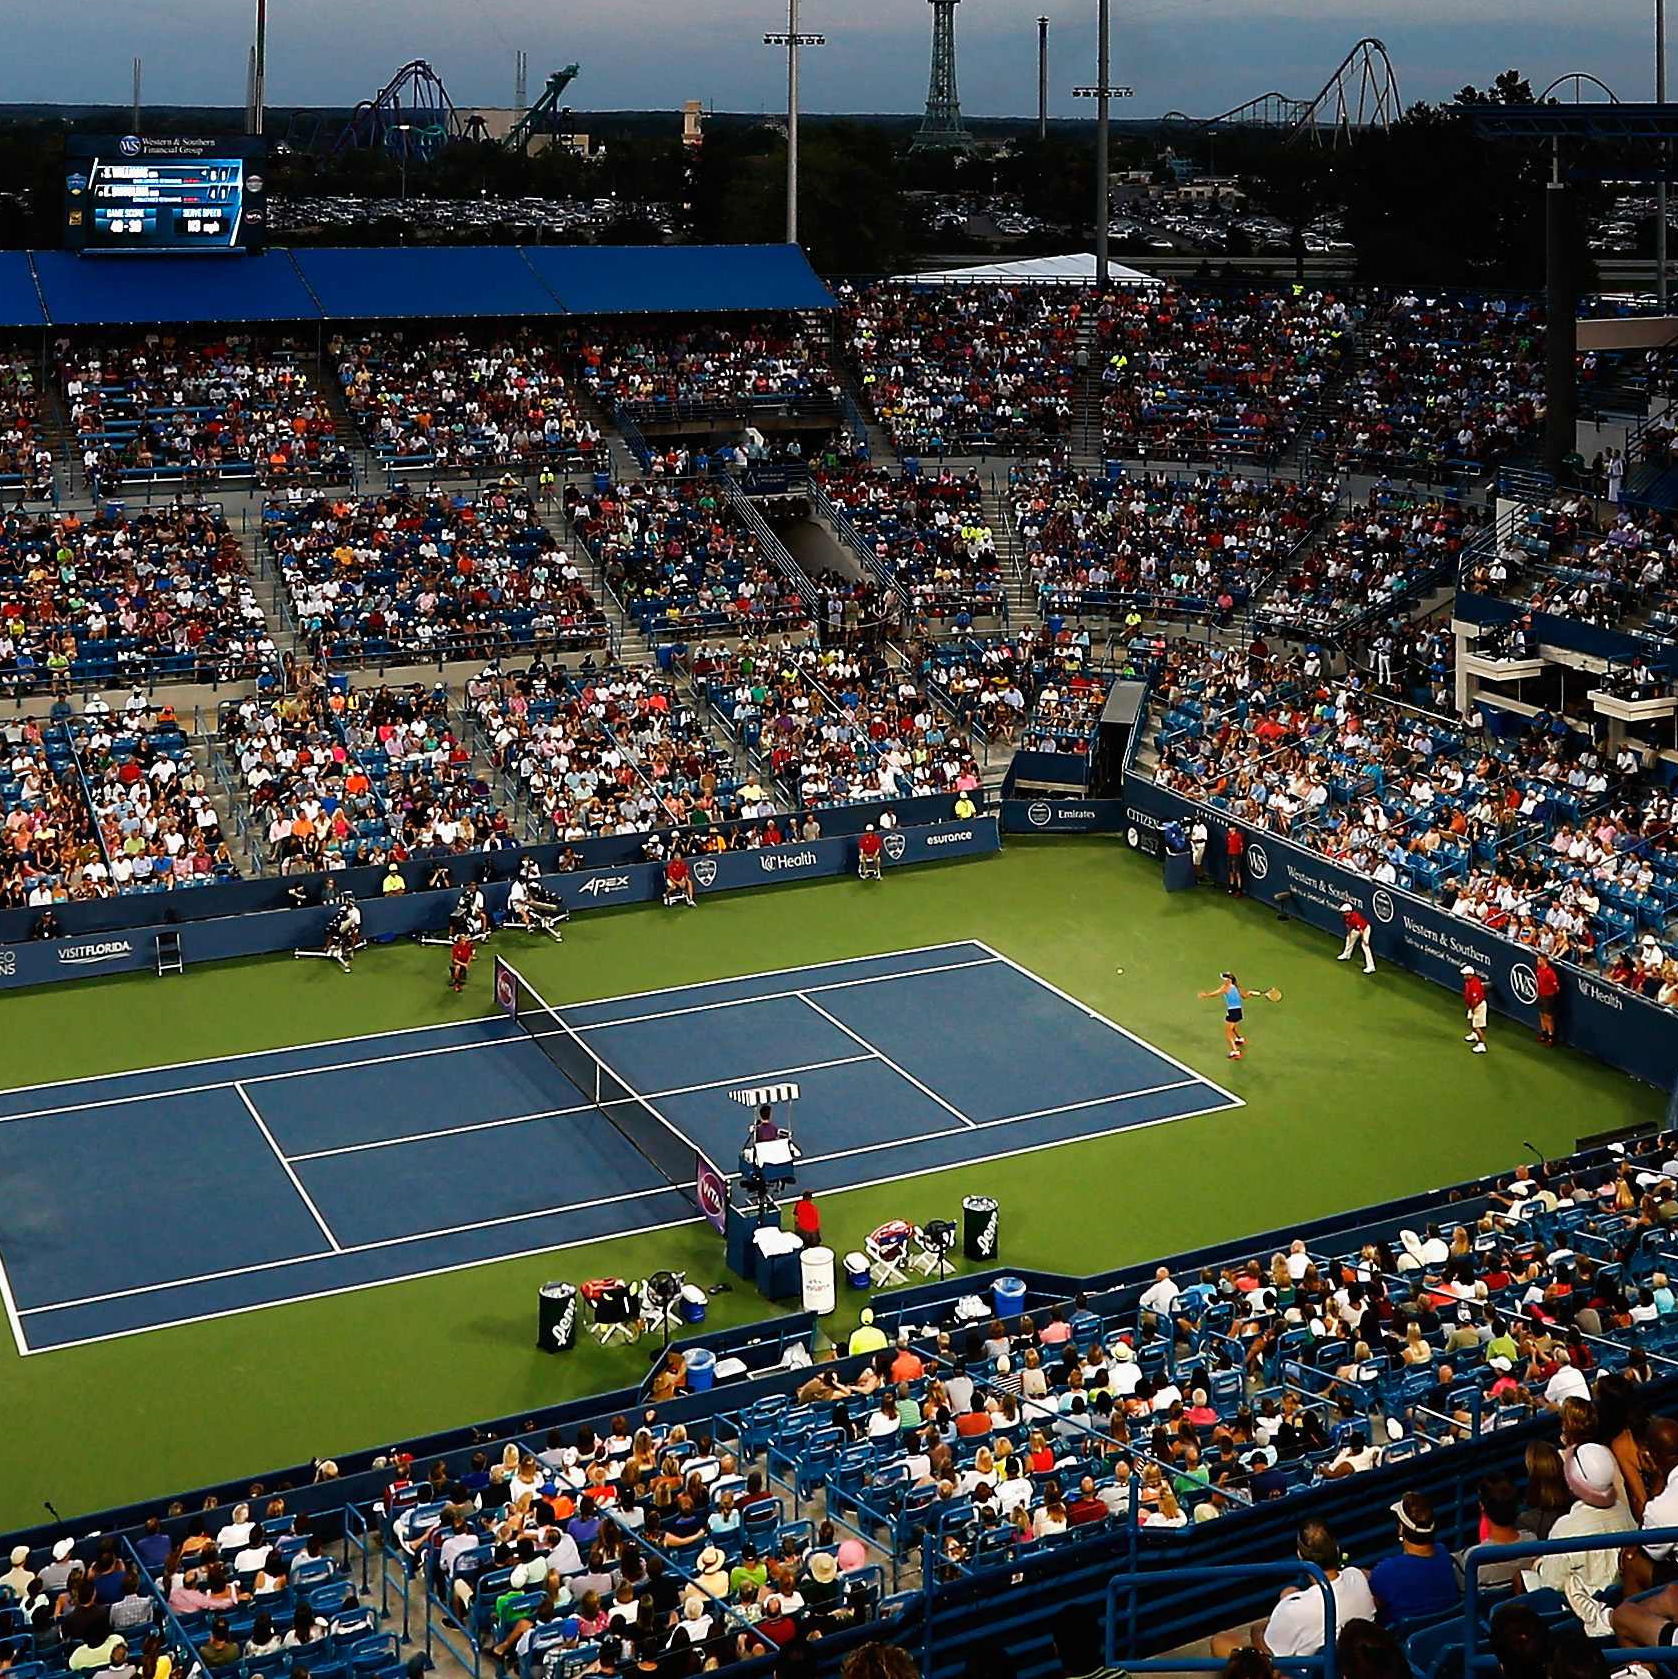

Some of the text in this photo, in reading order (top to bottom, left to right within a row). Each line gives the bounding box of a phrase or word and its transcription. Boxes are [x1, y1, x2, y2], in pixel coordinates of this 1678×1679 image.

[142, 137, 172, 146] Western
[182, 137, 216, 146] Southern
[143, 146, 204, 156] Financial Group
[1058, 809, 1096, 819] Emirates
[926, 831, 973, 845] esurance
[777, 851, 817, 869] Health
[578, 875, 630, 897] APEX
[1287, 864, 1318, 890] Western
[1319, 879, 1328, 893] &
[1328, 883, 1364, 910] Southern
[1402, 915, 1438, 943] Western
[1439, 932, 1449, 947] &
[1450, 936, 1492, 967] Southern
[1591, 986, 1623, 1010] Health
[703, 1181, 722, 1209] WTA
[977, 1211, 999, 1255] Penn
[552, 1297, 577, 1346] Penn
